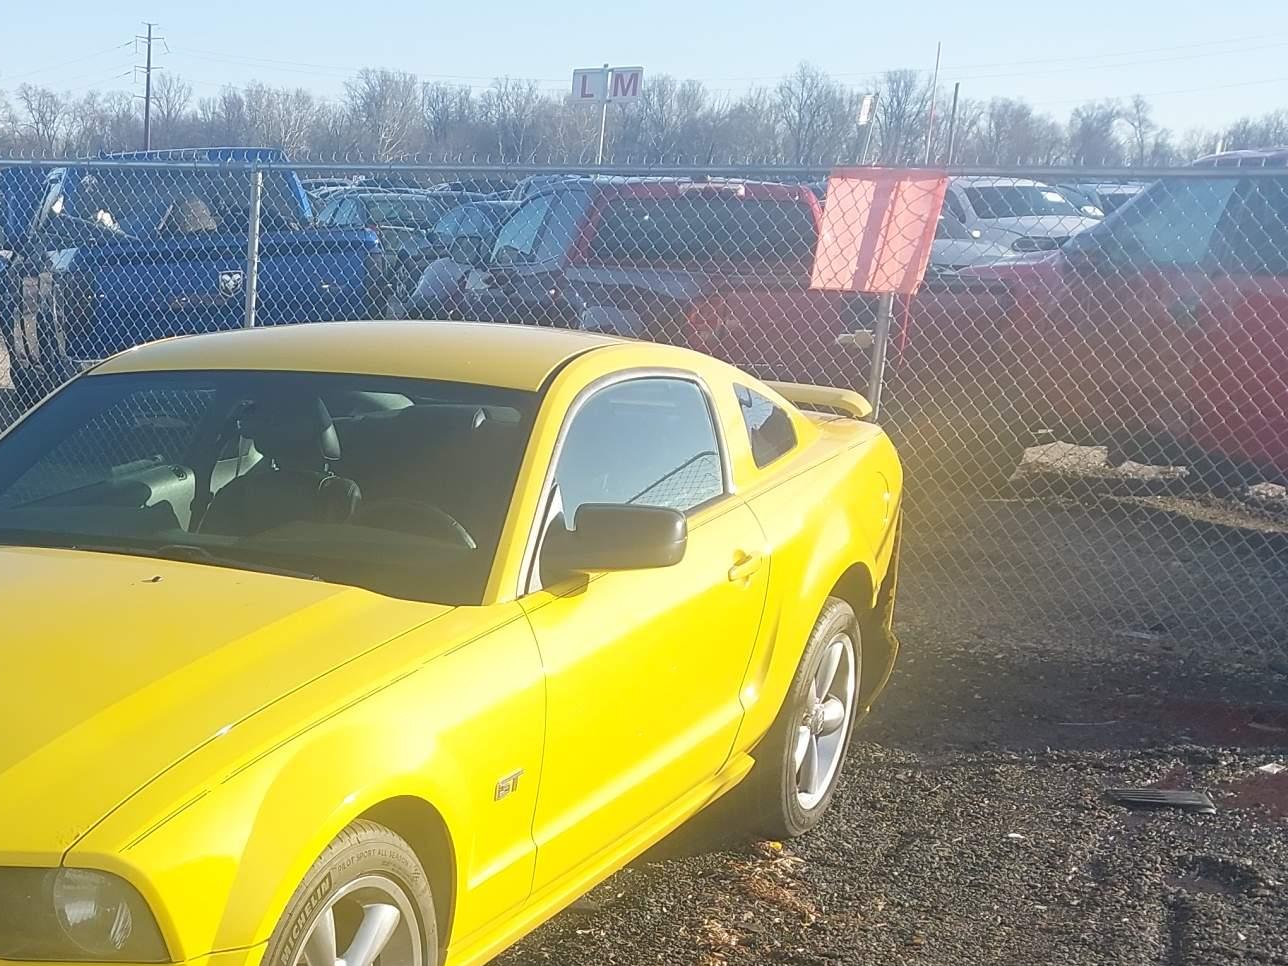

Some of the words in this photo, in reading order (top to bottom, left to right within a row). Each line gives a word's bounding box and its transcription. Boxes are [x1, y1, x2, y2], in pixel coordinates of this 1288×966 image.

[580, 75, 594, 98] L
[612, 72, 639, 97] M
[494, 768, 524, 802] GT
[280, 876, 331, 965] MICHELIN
